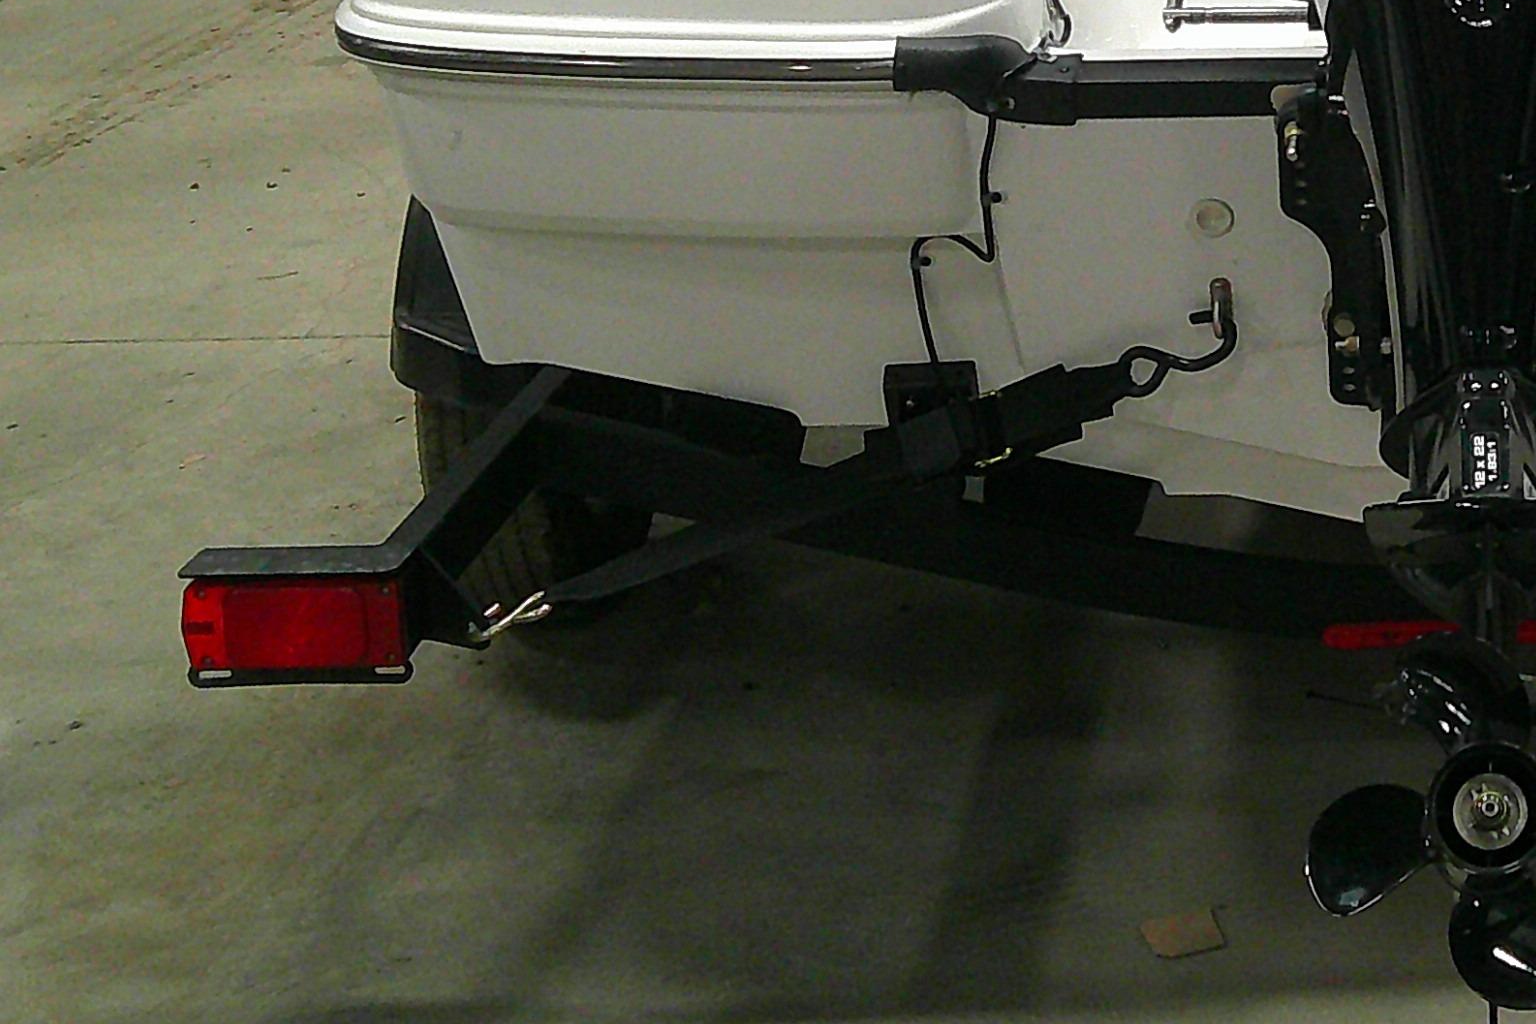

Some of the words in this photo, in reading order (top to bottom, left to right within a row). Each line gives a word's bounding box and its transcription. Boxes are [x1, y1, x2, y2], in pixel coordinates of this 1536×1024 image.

[1473, 435, 1485, 456] 22
[1487, 441, 1498, 482] 1.83:1
[1474, 471, 1486, 489] 12
